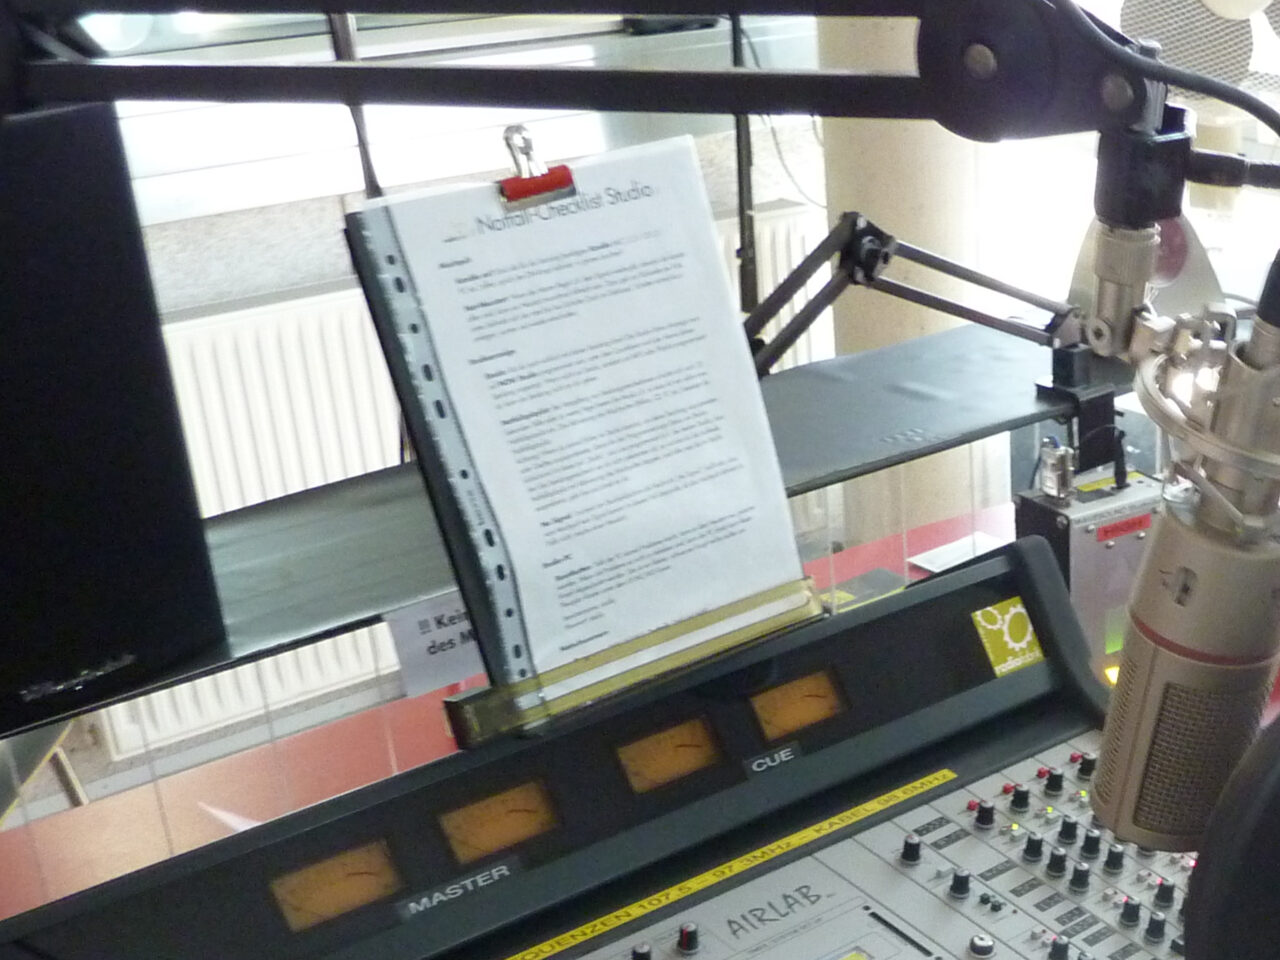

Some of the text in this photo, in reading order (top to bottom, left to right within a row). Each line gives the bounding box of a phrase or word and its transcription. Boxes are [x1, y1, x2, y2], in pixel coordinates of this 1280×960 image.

[427, 638, 457, 655] des
[751, 748, 795, 773] CUE
[813, 804, 874, 840] KABEL
[407, 863, 511, 916] MASTER
[726, 884, 822, 938] AIRLAB
